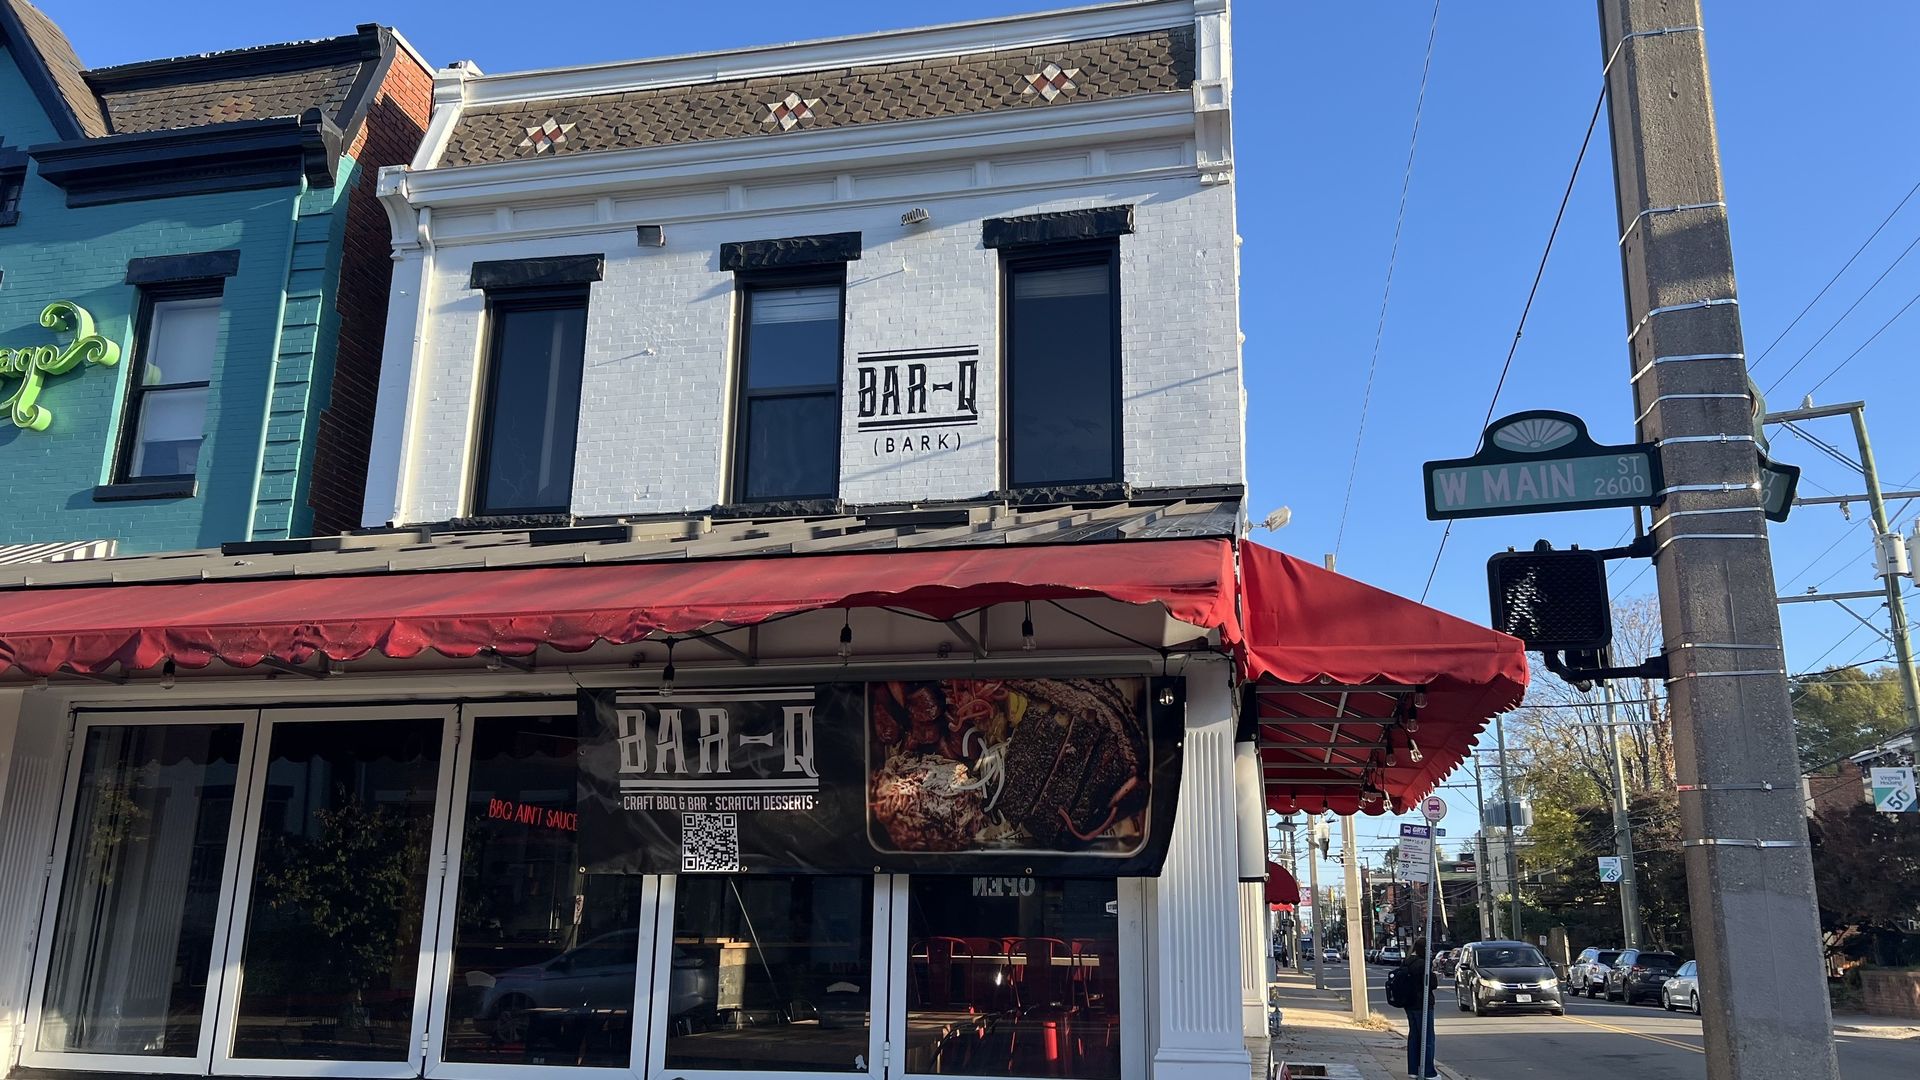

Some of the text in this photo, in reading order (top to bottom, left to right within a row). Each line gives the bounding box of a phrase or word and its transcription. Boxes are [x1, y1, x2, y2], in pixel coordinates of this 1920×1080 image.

[857, 360, 978, 417] BAR-Q
[874, 432, 961, 456] (BARK)
[1617, 456, 1640, 475] ST
[1439, 462, 1576, 506] W MAIN
[1594, 474, 1645, 496] 2600
[616, 705, 819, 777] BAR-Q
[489, 798, 578, 831] BBQ AIN'T SAUCE
[623, 796, 654, 810] CRAFT
[656, 796, 677, 810] BBQ
[687, 796, 707, 810] BAR
[715, 796, 760, 810] SCRATCH
[763, 795, 813, 810] DESSERTS
